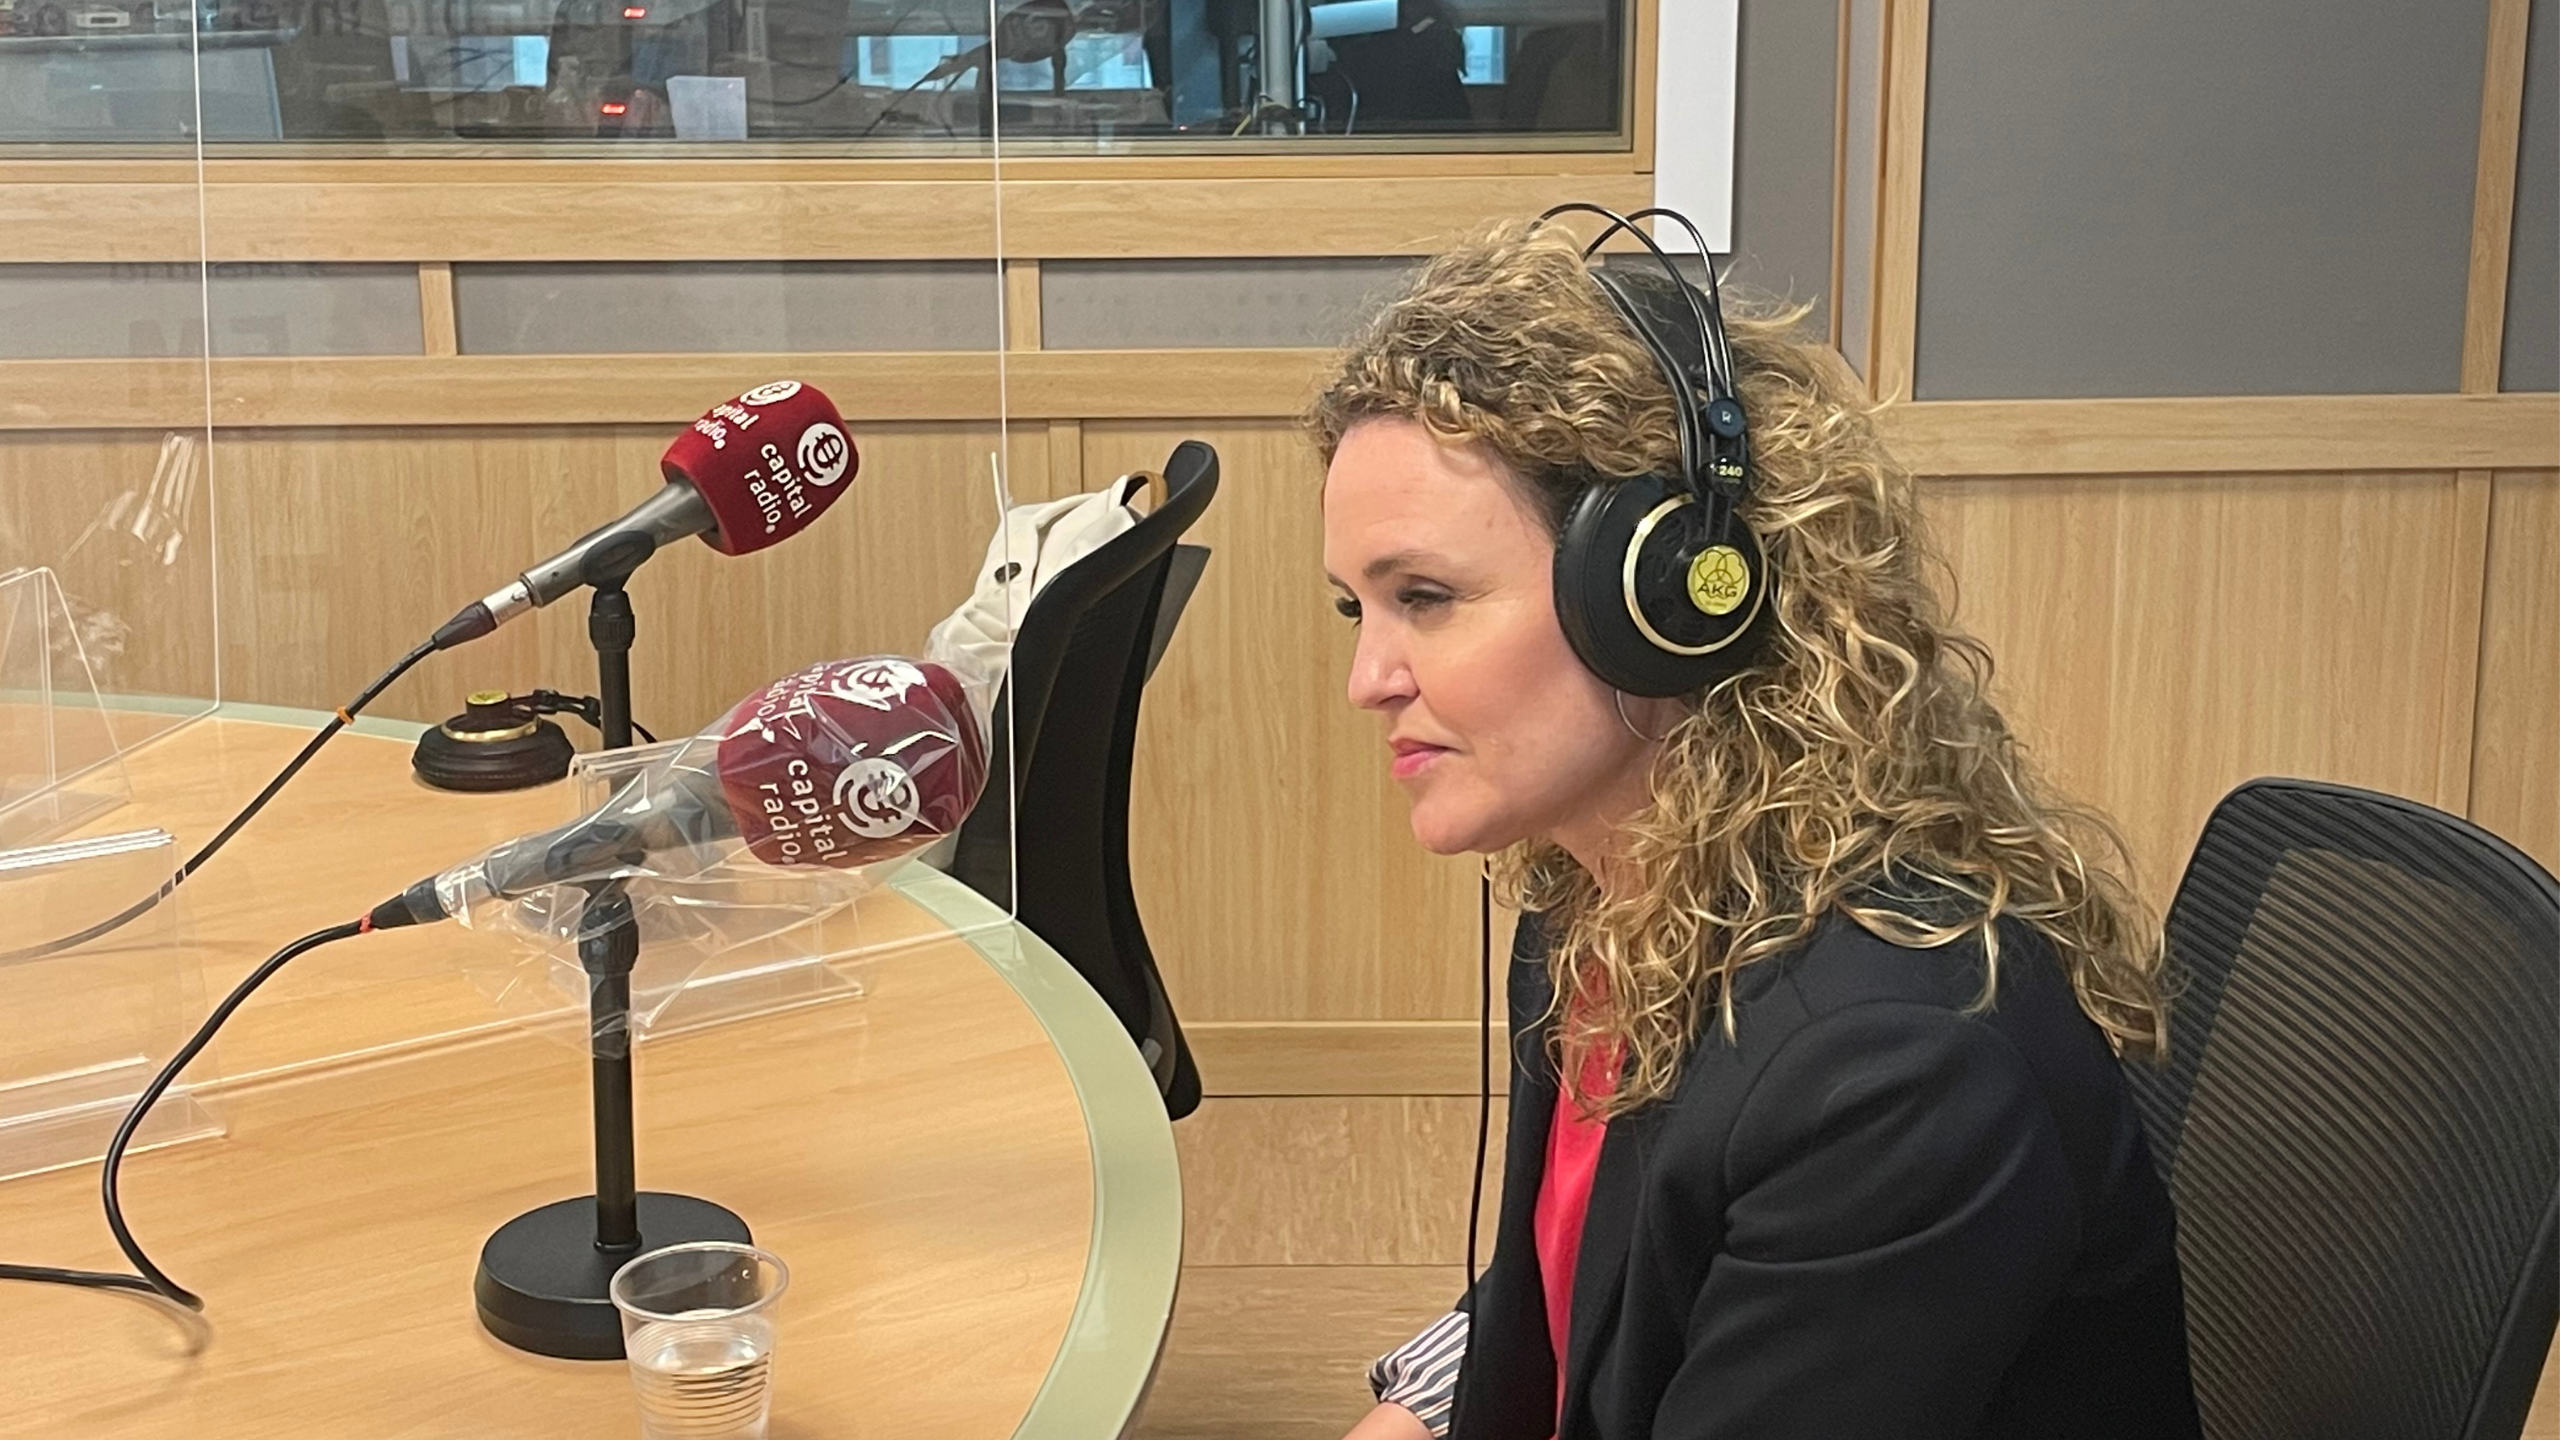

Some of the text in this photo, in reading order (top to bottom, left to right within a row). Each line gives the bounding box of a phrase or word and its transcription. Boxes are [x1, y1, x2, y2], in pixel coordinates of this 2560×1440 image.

[1721, 410, 1732, 424] R
[744, 469, 781, 534] radio.
[761, 443, 812, 519] capital
[1697, 582, 1738, 598] AKG
[788, 759, 848, 861] capital
